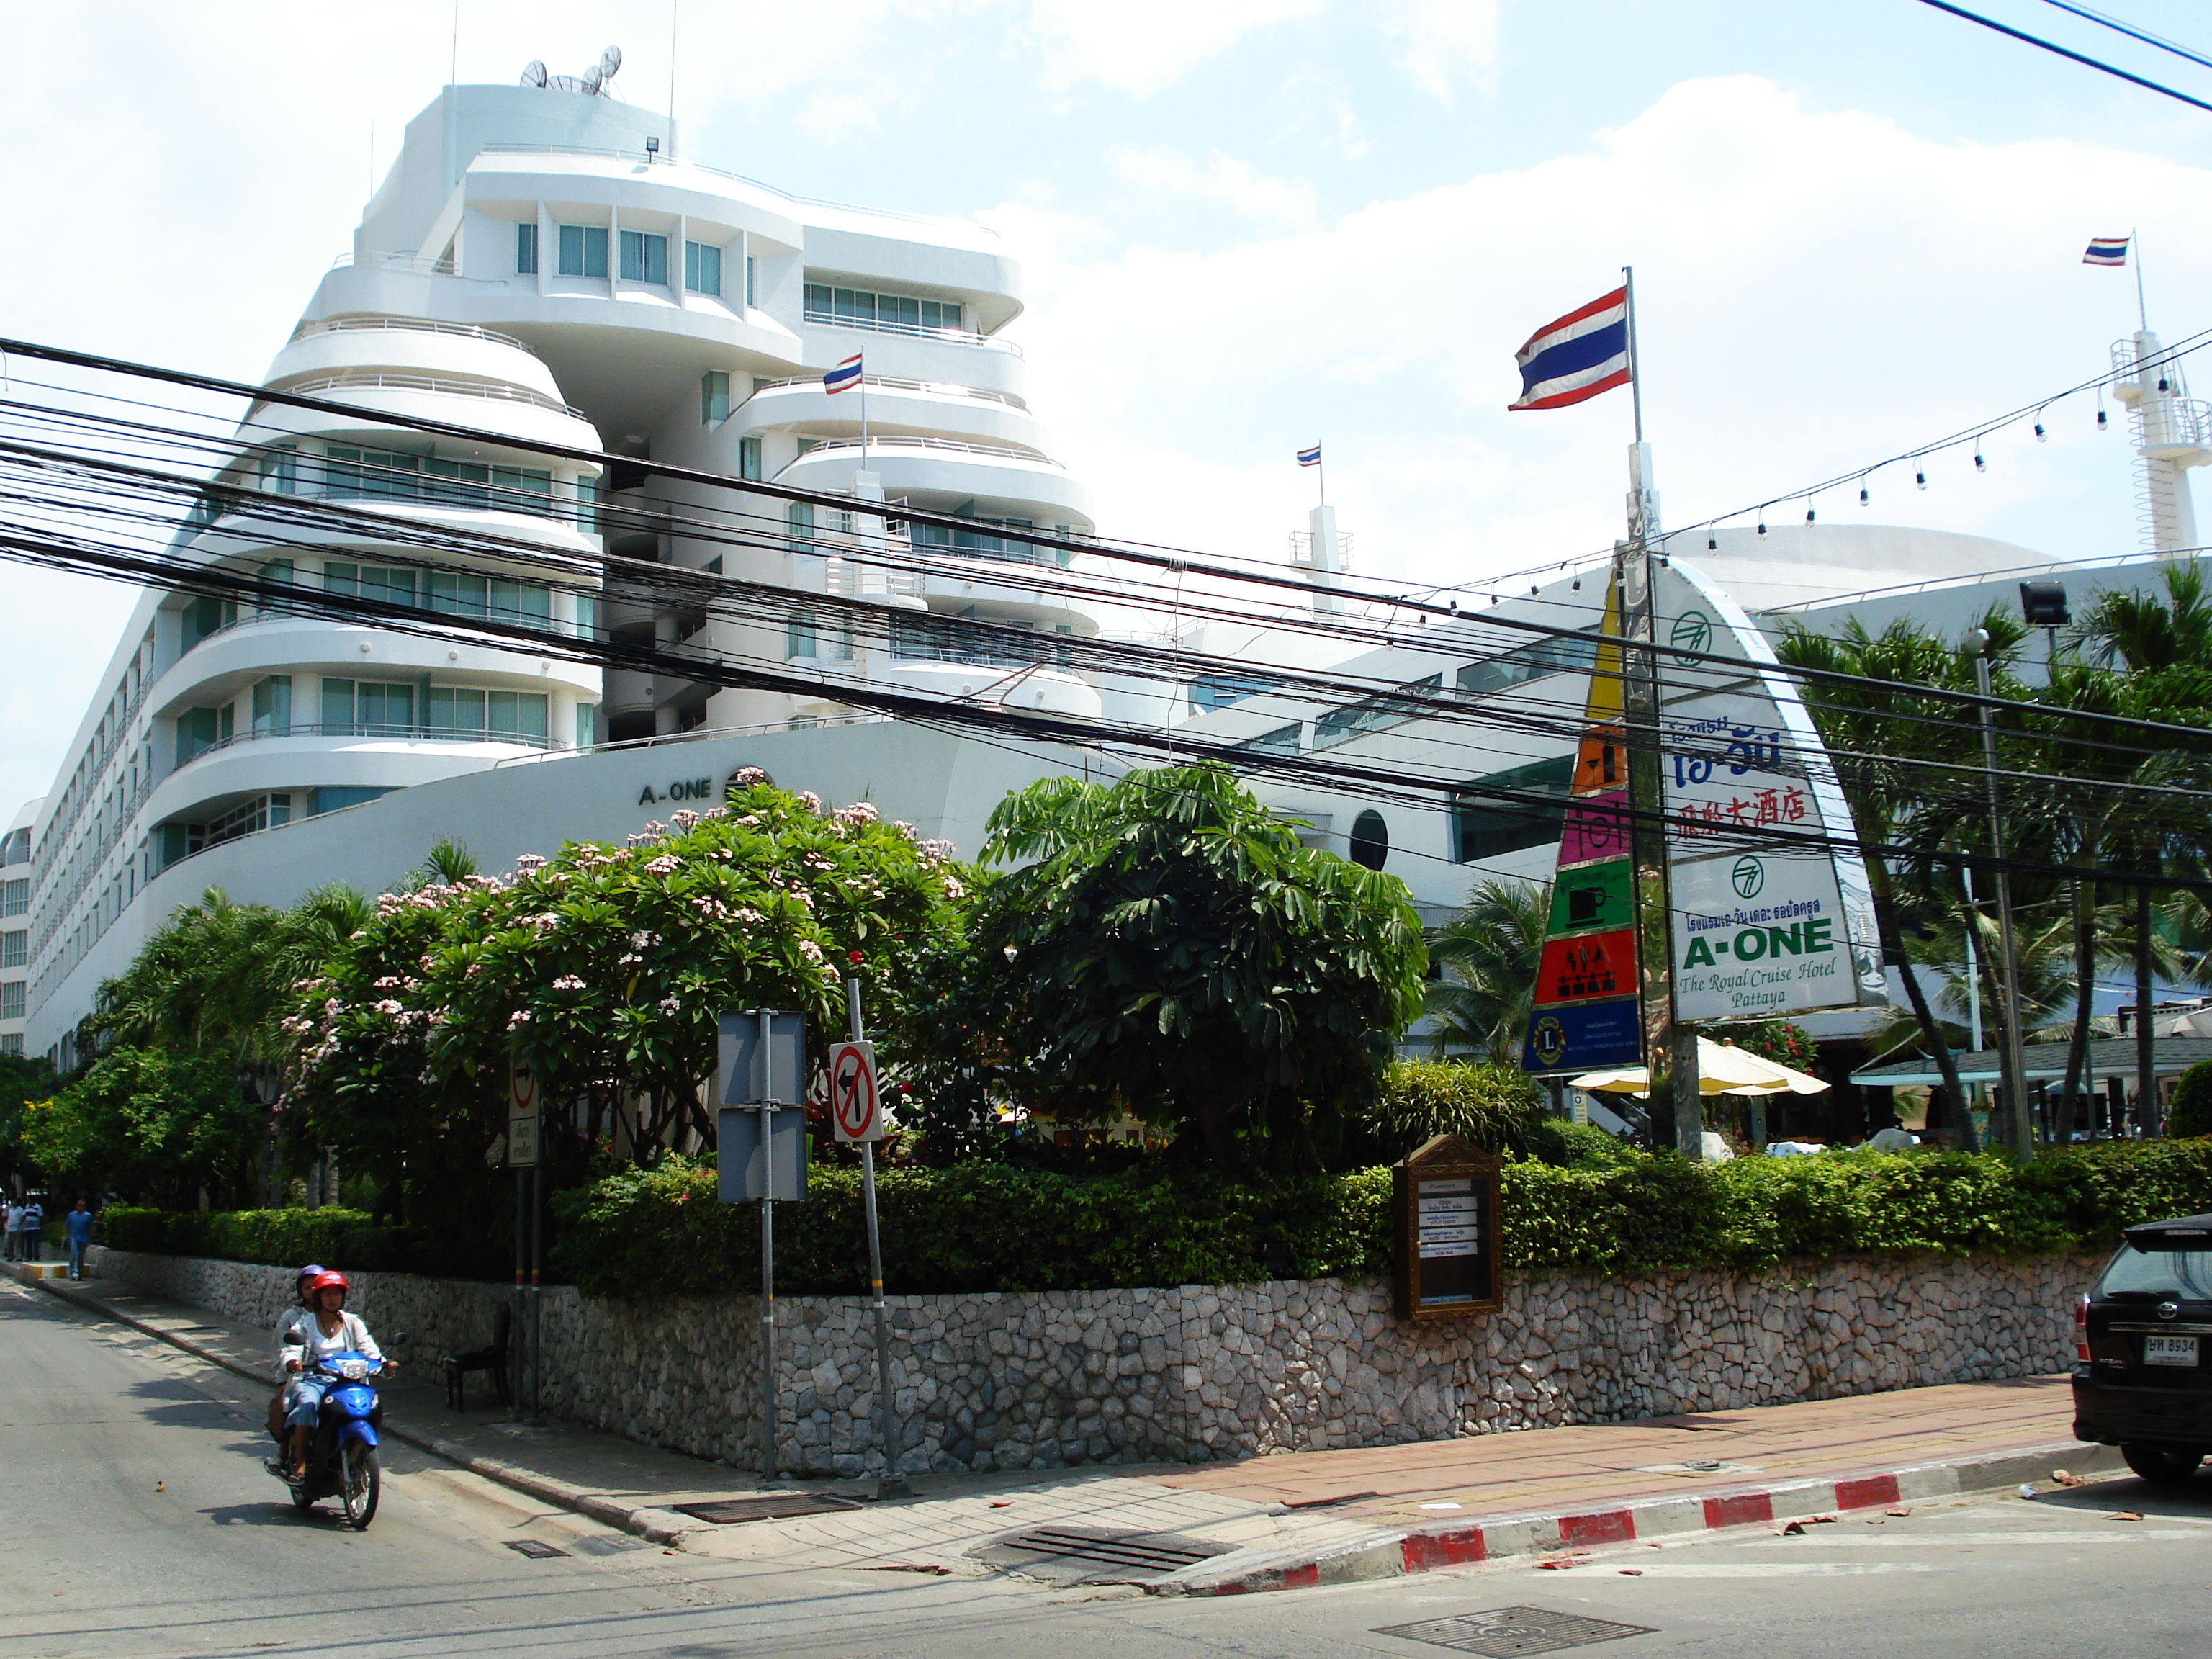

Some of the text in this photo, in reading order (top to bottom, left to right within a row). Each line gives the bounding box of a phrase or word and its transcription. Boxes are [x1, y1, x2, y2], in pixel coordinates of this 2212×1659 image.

[638, 775, 712, 805] A-ONE
[1750, 908, 1771, 923] เดอะ
[1683, 918, 1834, 970] A-ONE
[1680, 957, 1837, 994] The Royal Cruise Hotel
[1732, 989, 1786, 1010] Pattaya
[1544, 1030, 1555, 1050] L
[2168, 1339, 2195, 1352] 8934
